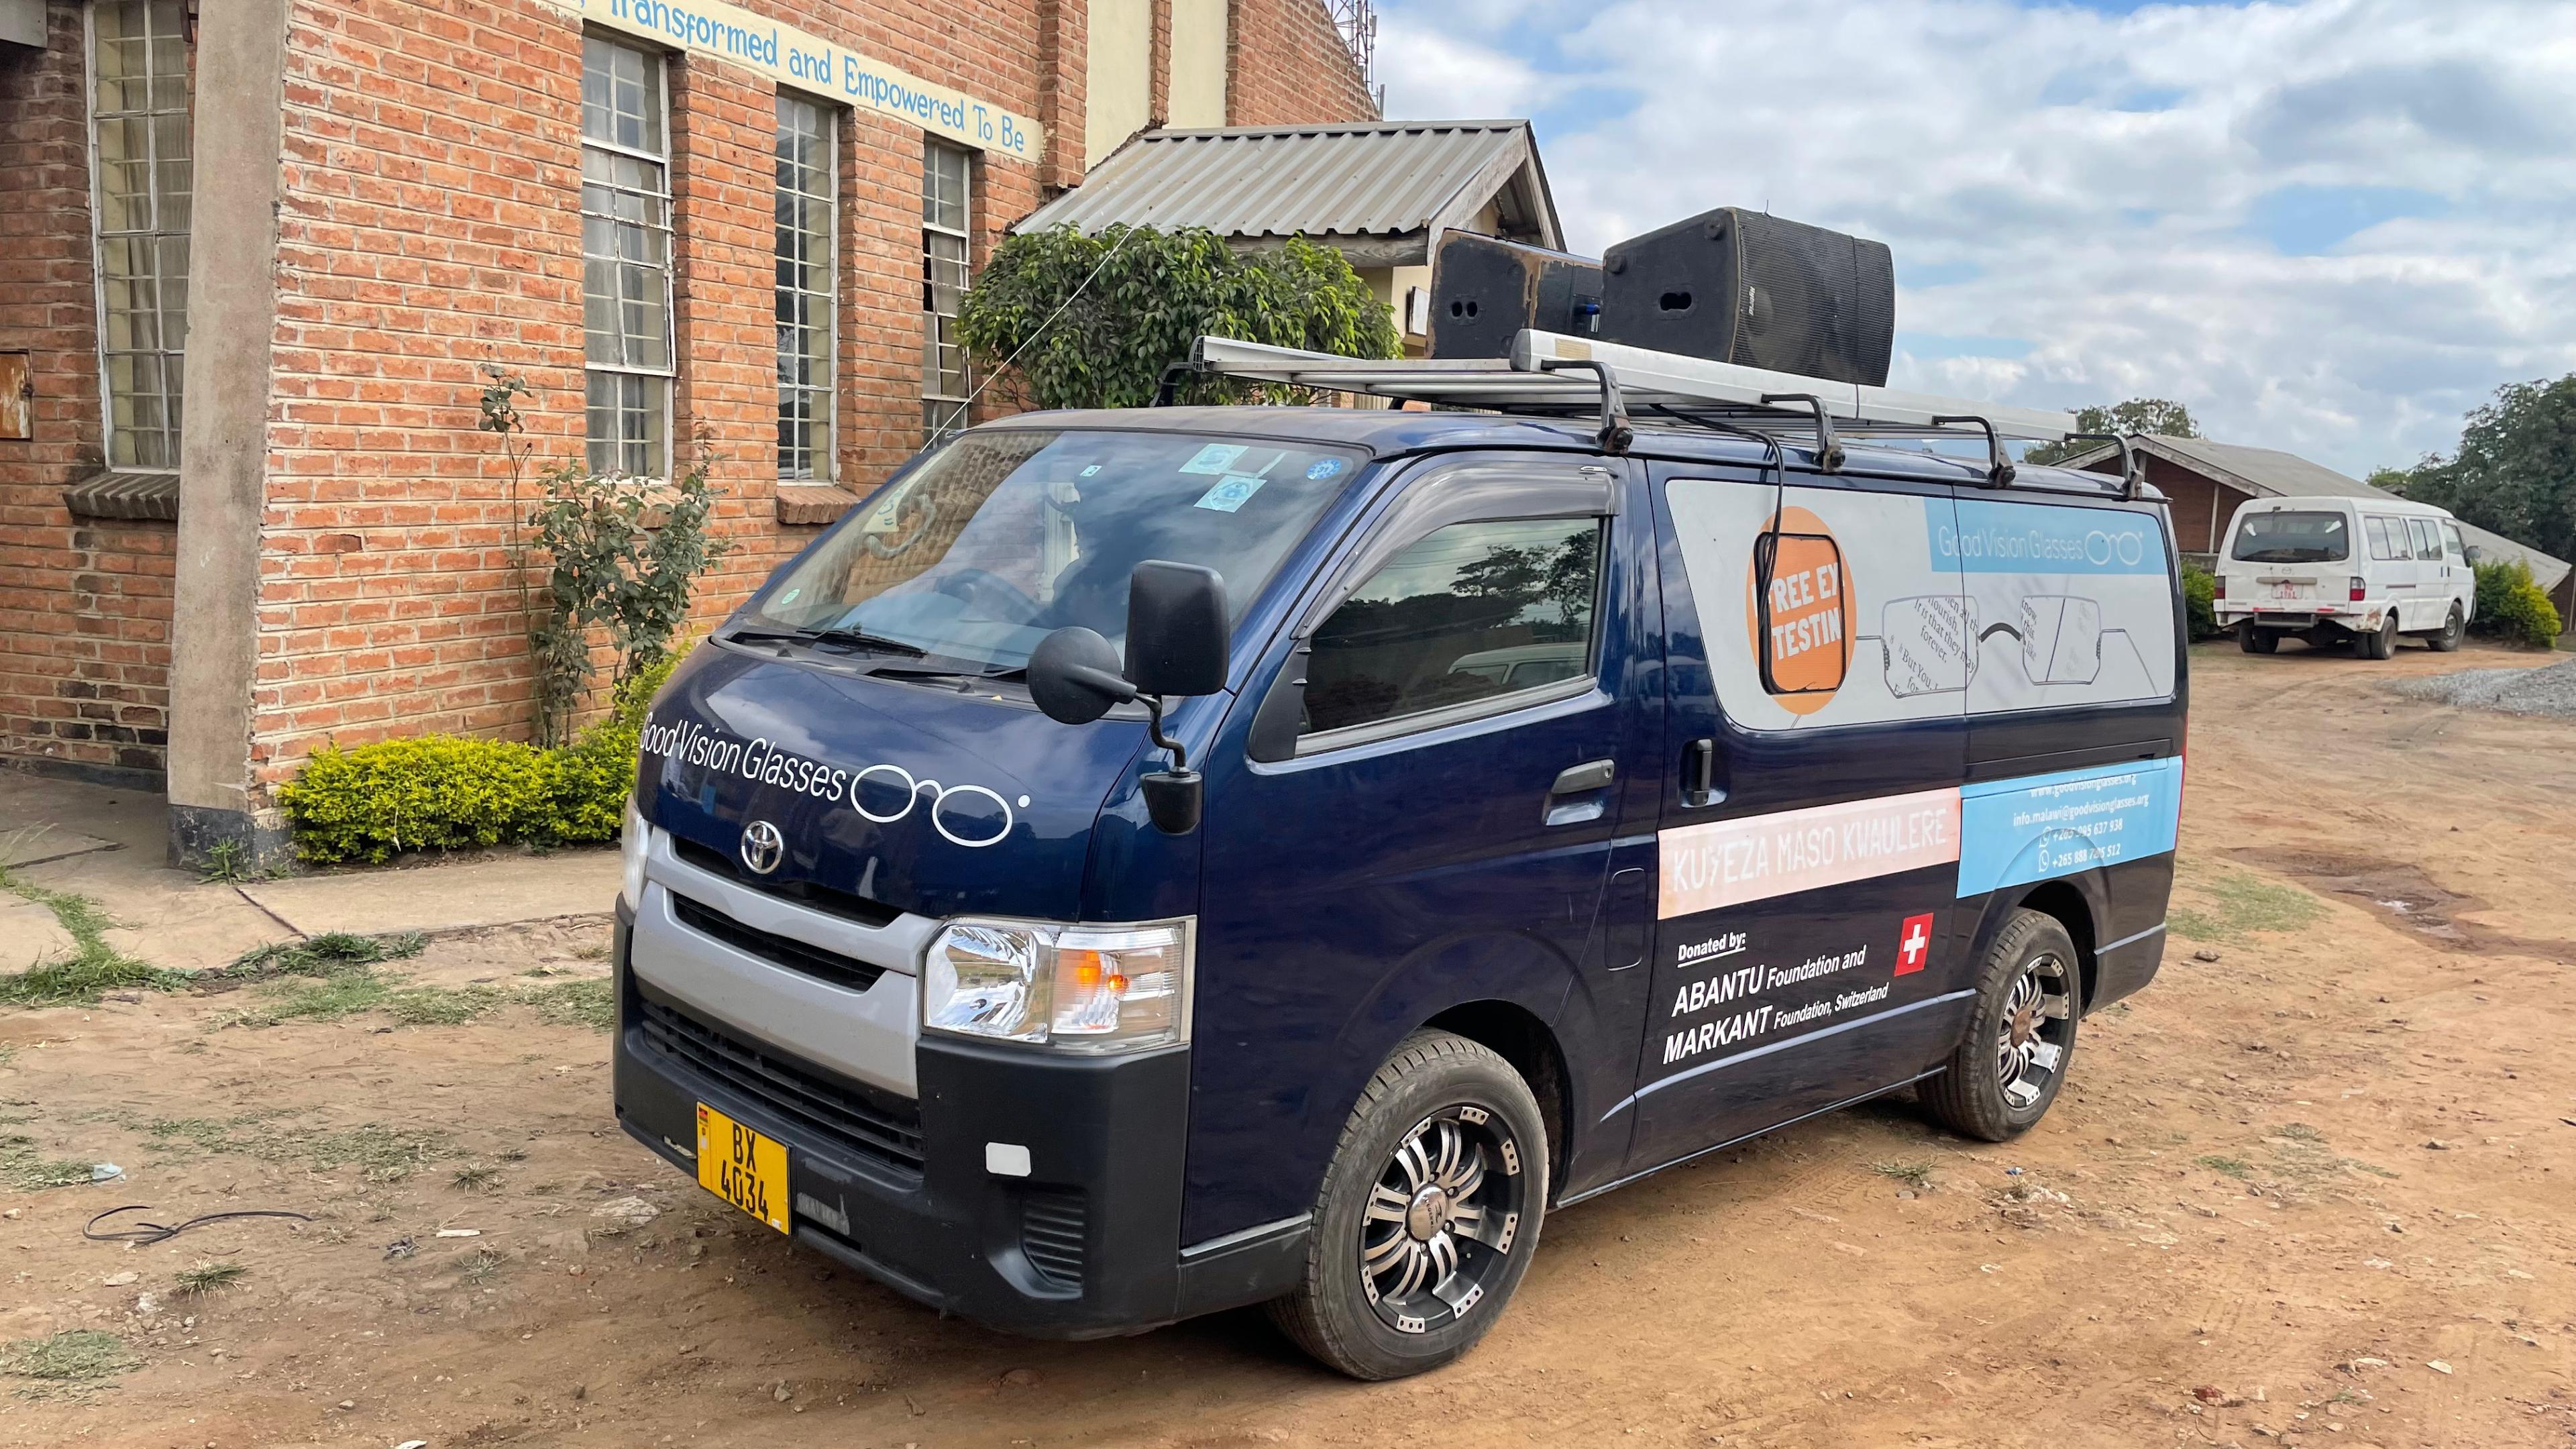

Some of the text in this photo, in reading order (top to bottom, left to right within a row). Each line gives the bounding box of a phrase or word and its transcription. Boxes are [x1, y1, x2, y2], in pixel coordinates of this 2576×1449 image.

[789, 48, 832, 85] and
[844, 55, 965, 131] Empowered
[973, 105, 993, 141] To
[1002, 115, 1024, 152] Be
[1816, 562, 1844, 599] EY
[1771, 607, 1842, 661] TESTIN
[1928, 614, 1944, 638] that
[1944, 631, 1961, 656] they
[2031, 775, 2137, 798] www.goodvisionglasses.org
[2014, 794, 2149, 826] info.malawi@goodvisionglasses.org
[2094, 821, 2108, 835] 637
[2110, 818, 2123, 832] 938
[1777, 826, 1835, 873] MASO
[1843, 808, 1948, 861] KWAULERE
[2052, 853, 2072, 868] +265
[2107, 843, 2121, 857] 512
[1678, 932, 1746, 961] Donated by:
[1671, 945, 1867, 1017] ABANTU Foundation and
[1662, 981, 1890, 1065] MARKANT Foundation, Switzerland
[733, 1122, 757, 1173] BX
[721, 1159, 769, 1222] 4034
